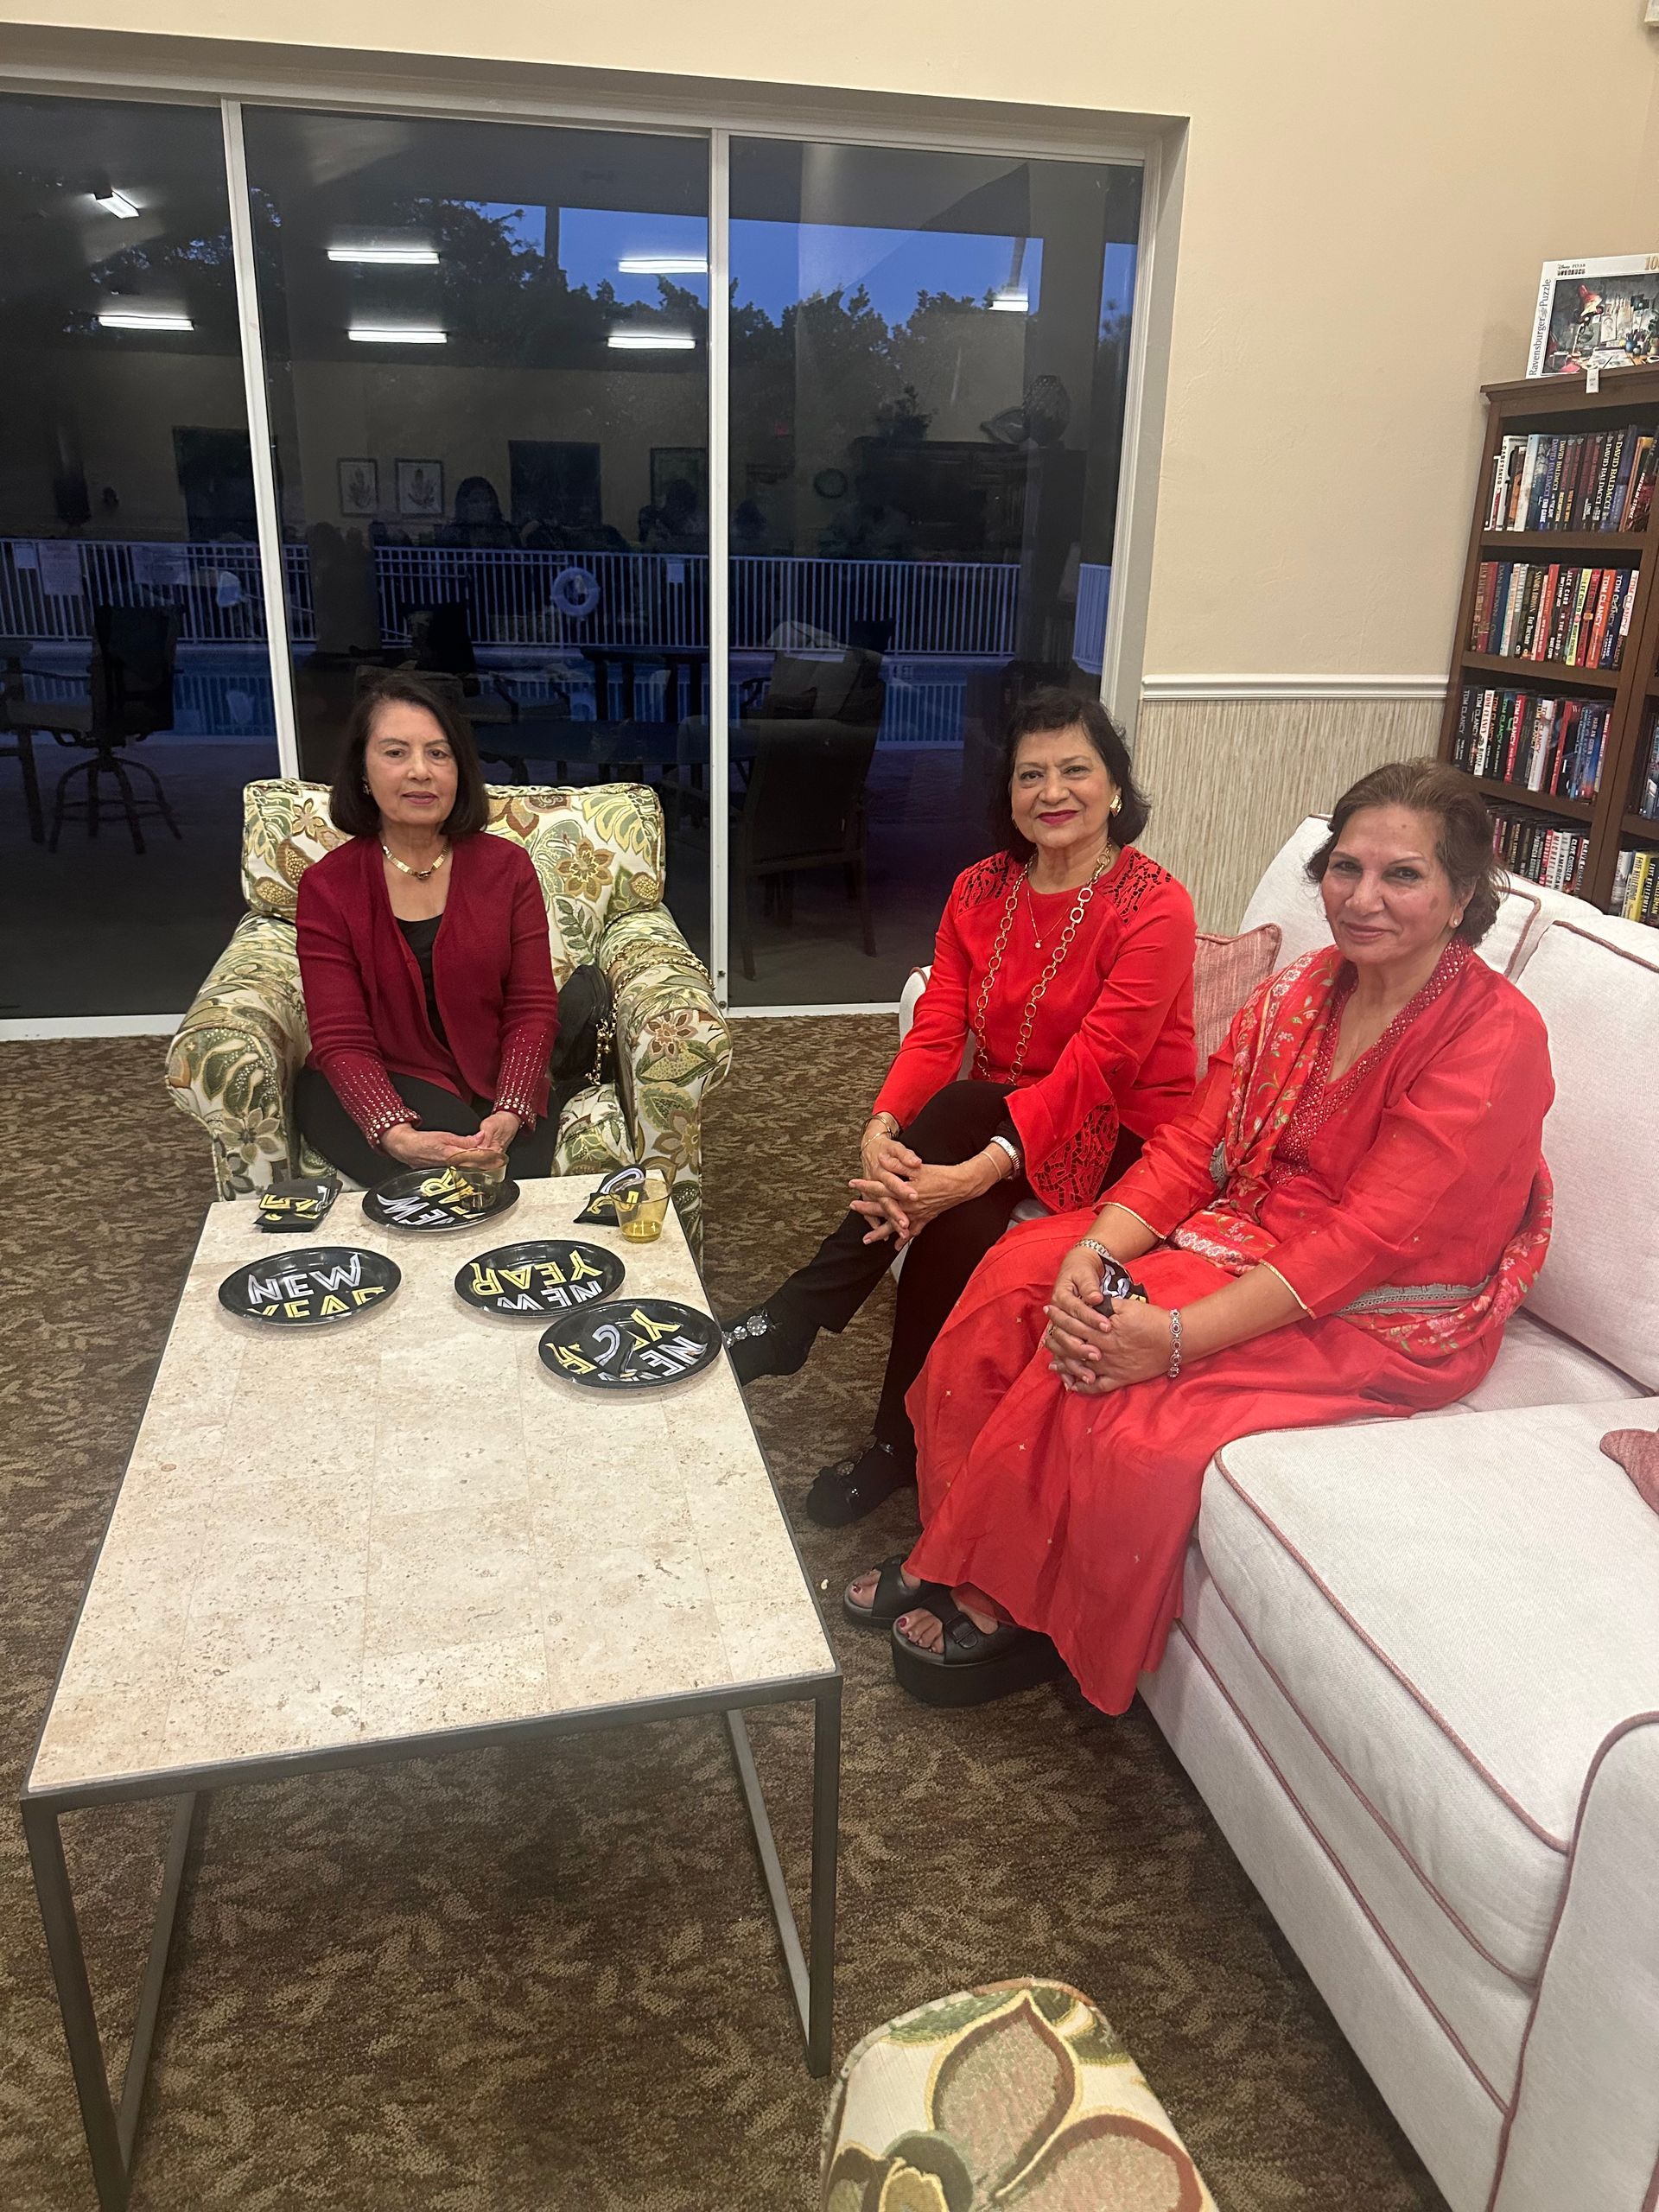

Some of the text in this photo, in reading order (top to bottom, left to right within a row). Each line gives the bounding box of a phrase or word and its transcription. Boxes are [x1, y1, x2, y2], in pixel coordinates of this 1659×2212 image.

[1644, 256, 1659, 270] 10
[1529, 278, 1551, 376] Ravensburger Puzzle
[1613, 442, 1622, 467] DAVID
[1545, 462, 1554, 496] BALDACCI
[1554, 461, 1562, 490] BALDACCI
[1597, 468, 1607, 504] BALDACCI
[1605, 468, 1618, 509] BALDACCI
[1628, 472, 1646, 519] KREMLIN STRIKE
[1534, 571, 1542, 591] SANDRA
[1566, 571, 1574, 586] JACK
[1530, 592, 1539, 612] BROWN
[1596, 594, 1606, 626] CLANCY
[1609, 594, 1619, 626] CLANCY
[1622, 595, 1633, 629] CLANCY
[1472, 709, 1481, 736] CLANCY
[1550, 835, 1559, 868] MICHAEL
[1555, 854, 1564, 889] AMERICAN
[1641, 863, 1656, 912] FAYE KELLERMAN
[247, 1253, 362, 1305] NEW
[469, 1249, 604, 1297] YEAR
[497, 1280, 603, 1311] NEW
[597, 1335, 709, 1382] NE
